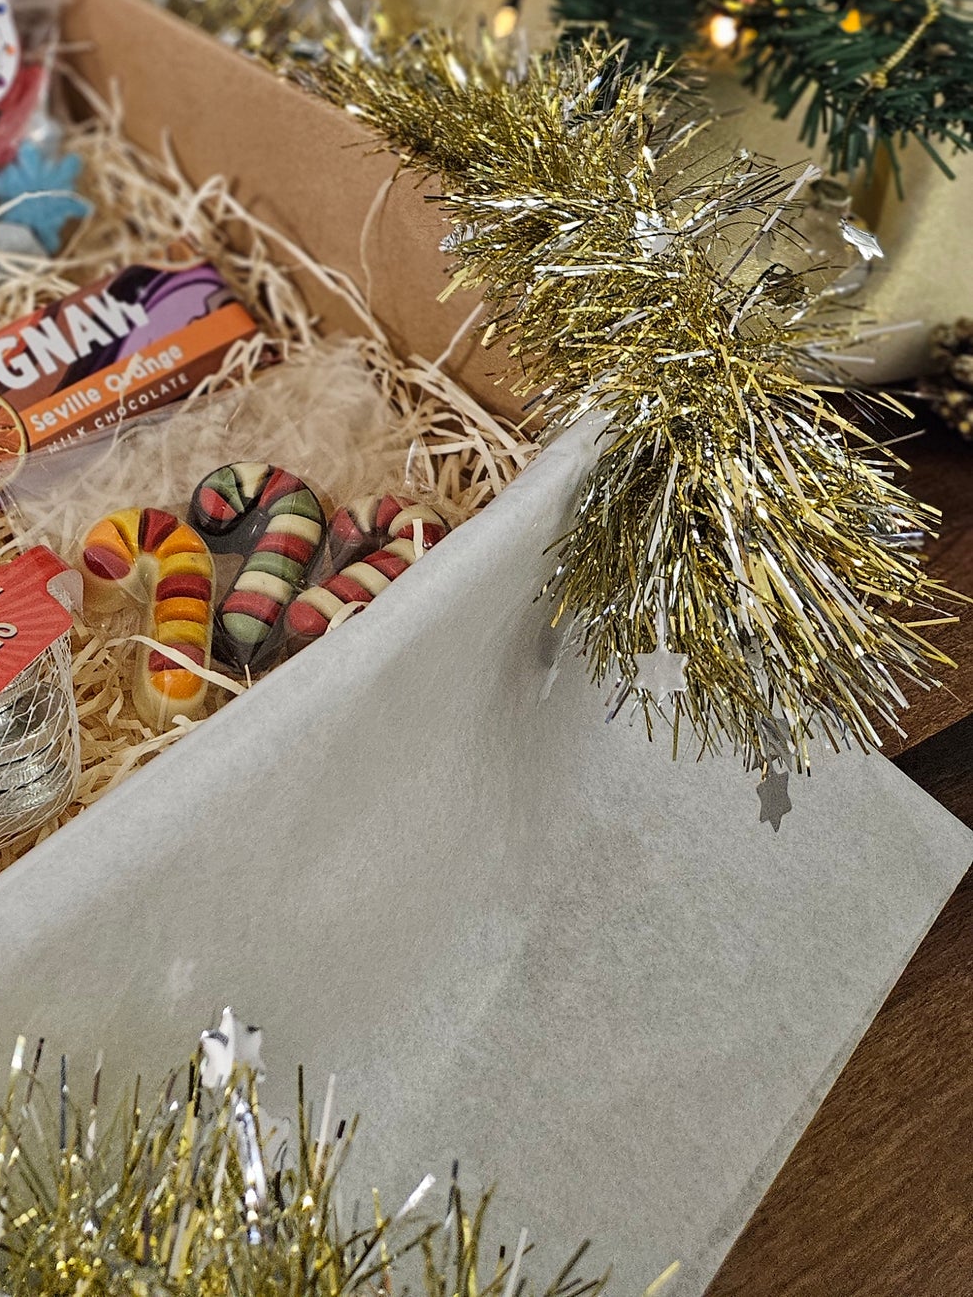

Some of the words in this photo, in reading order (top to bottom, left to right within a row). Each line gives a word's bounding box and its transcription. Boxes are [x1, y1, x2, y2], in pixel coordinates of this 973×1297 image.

[30, 386, 102, 432] Seville
[47, 427, 88, 454] MILK
[94, 372, 190, 429] CHOCOLATE
